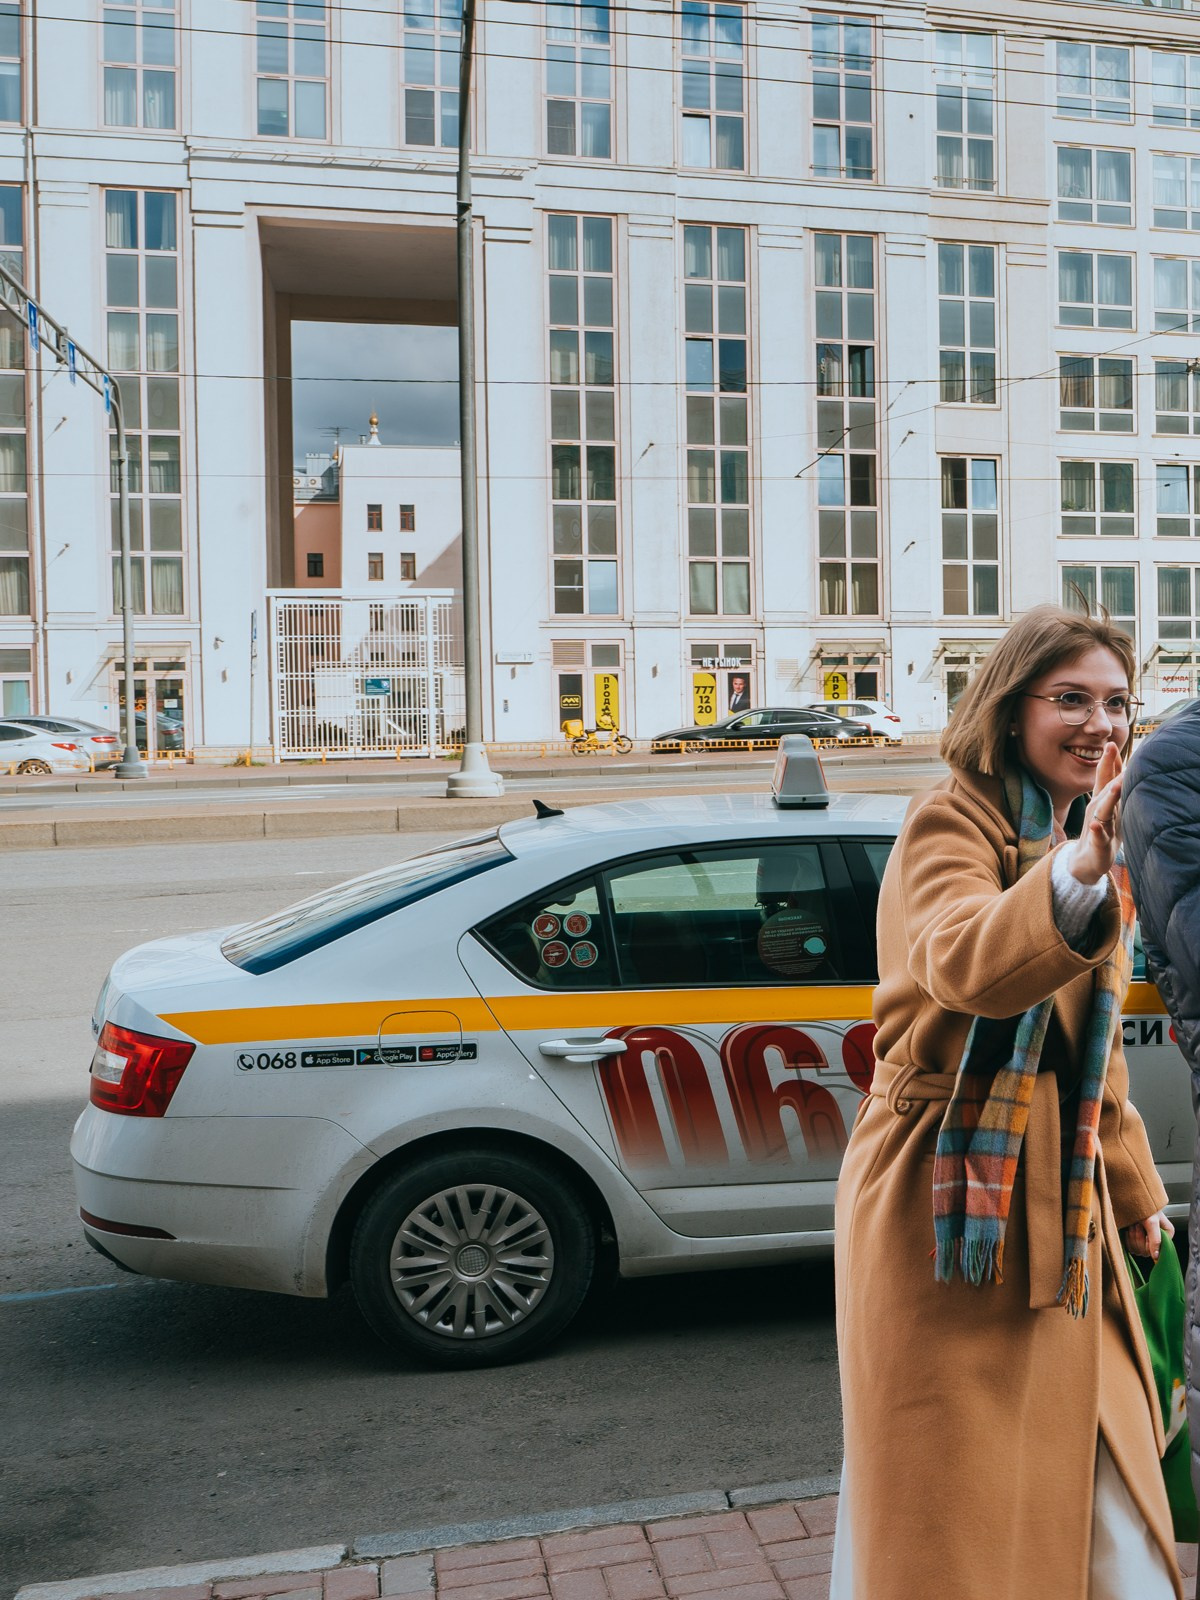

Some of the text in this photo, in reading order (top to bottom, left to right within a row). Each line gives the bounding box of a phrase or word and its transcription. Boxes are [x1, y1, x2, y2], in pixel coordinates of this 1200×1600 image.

[694, 686, 715, 695] 777
[699, 695, 711, 704] 12
[697, 705, 713, 714] 20
[256, 1051, 297, 1070] 068
[316, 1056, 351, 1065] App Store
[399, 1053, 413, 1061] Play
